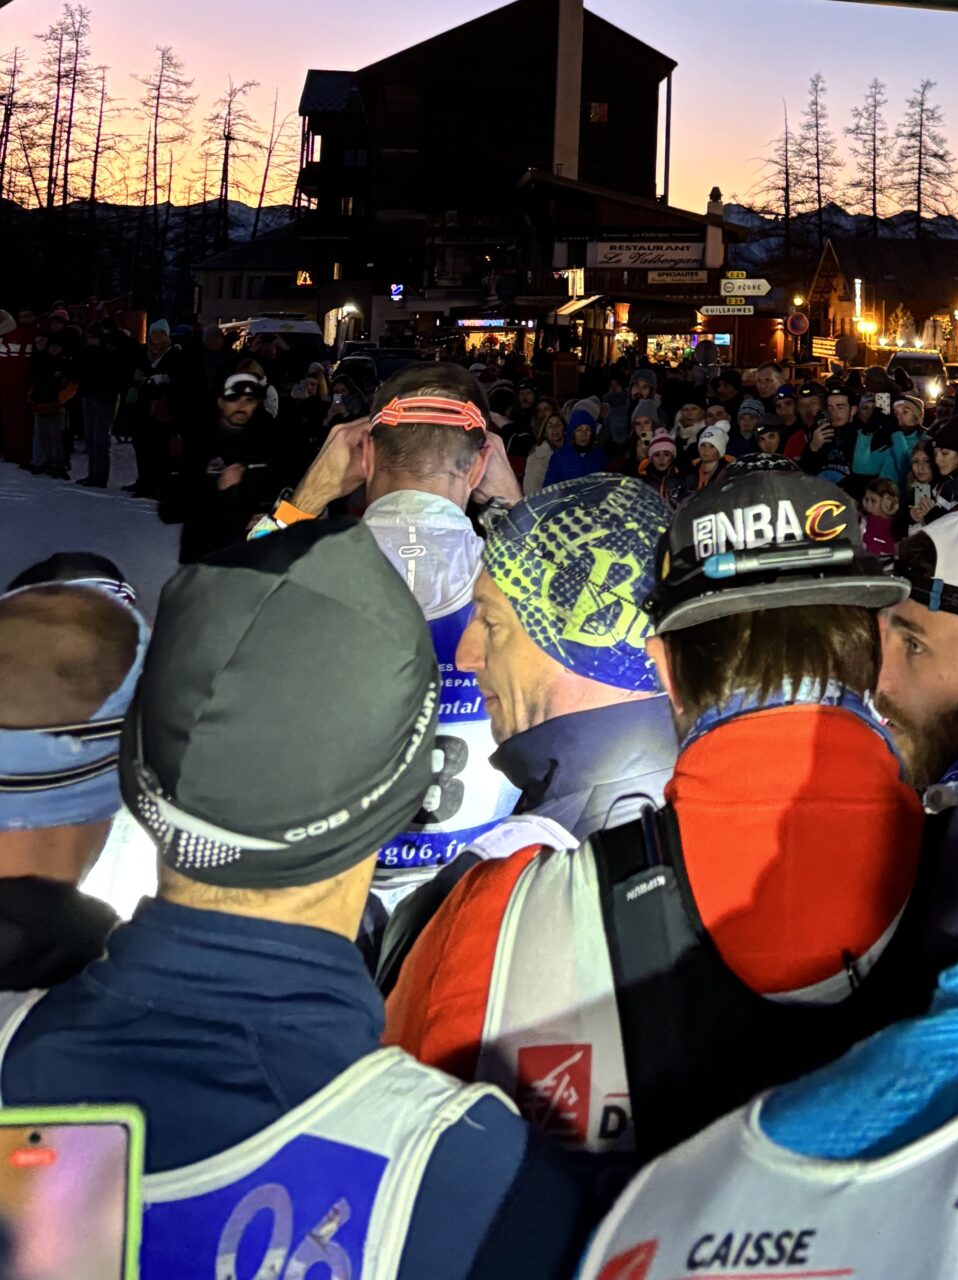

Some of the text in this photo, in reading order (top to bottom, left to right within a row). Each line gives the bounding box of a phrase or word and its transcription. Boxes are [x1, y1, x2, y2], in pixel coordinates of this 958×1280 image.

[716, 500, 804, 554] NBA
[438, 696, 481, 715] ntal
[284, 810, 350, 843] COB
[686, 1228, 817, 1270] CAISSE
